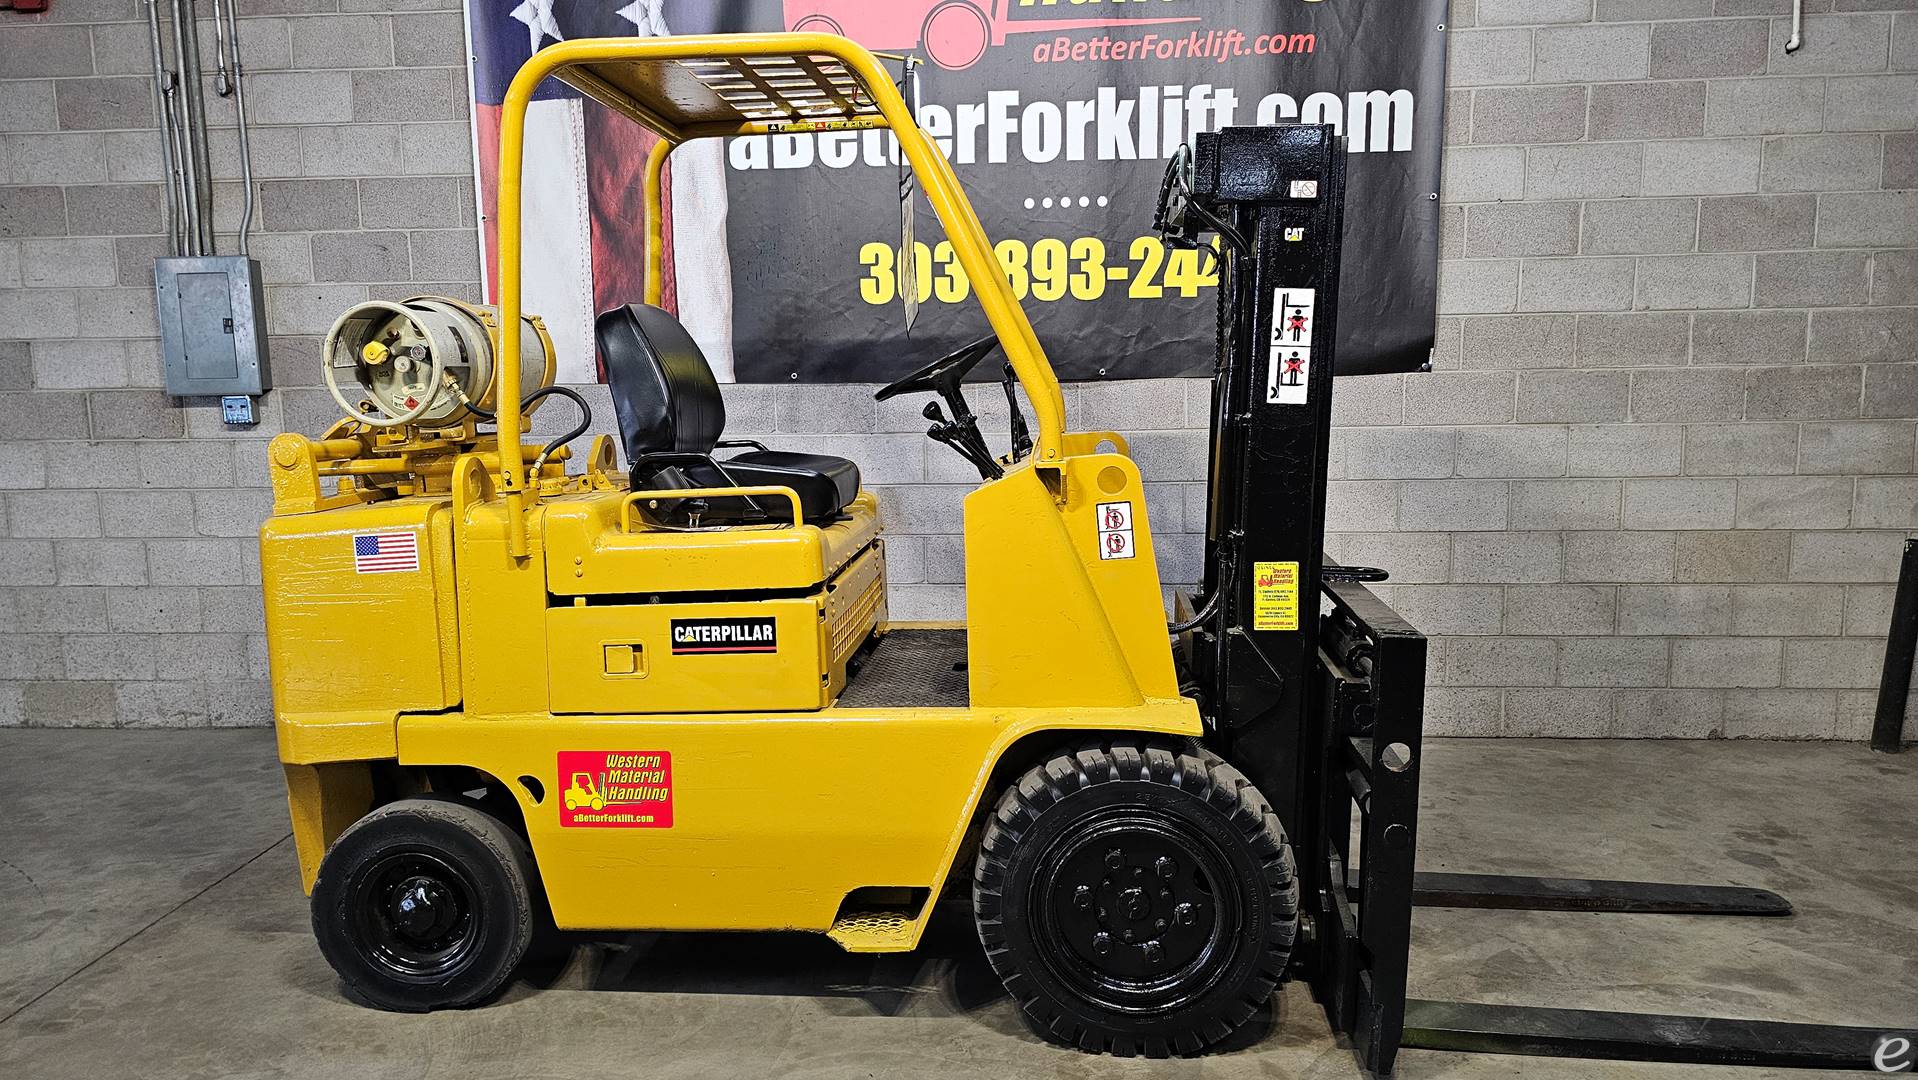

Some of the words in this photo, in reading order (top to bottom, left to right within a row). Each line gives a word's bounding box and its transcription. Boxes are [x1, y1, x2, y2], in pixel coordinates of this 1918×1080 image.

[1033, 30, 1317, 63] aBetterForklift.com
[728, 84, 1414, 171] aBeterForkliftcom
[1284, 227, 1304, 242] CAT
[674, 624, 773, 642] CATERPILLAR
[606, 754, 661, 768] Western
[608, 770, 665, 784] Material
[608, 786, 669, 802] Handling
[573, 813, 654, 823] aBetterForklift.com
